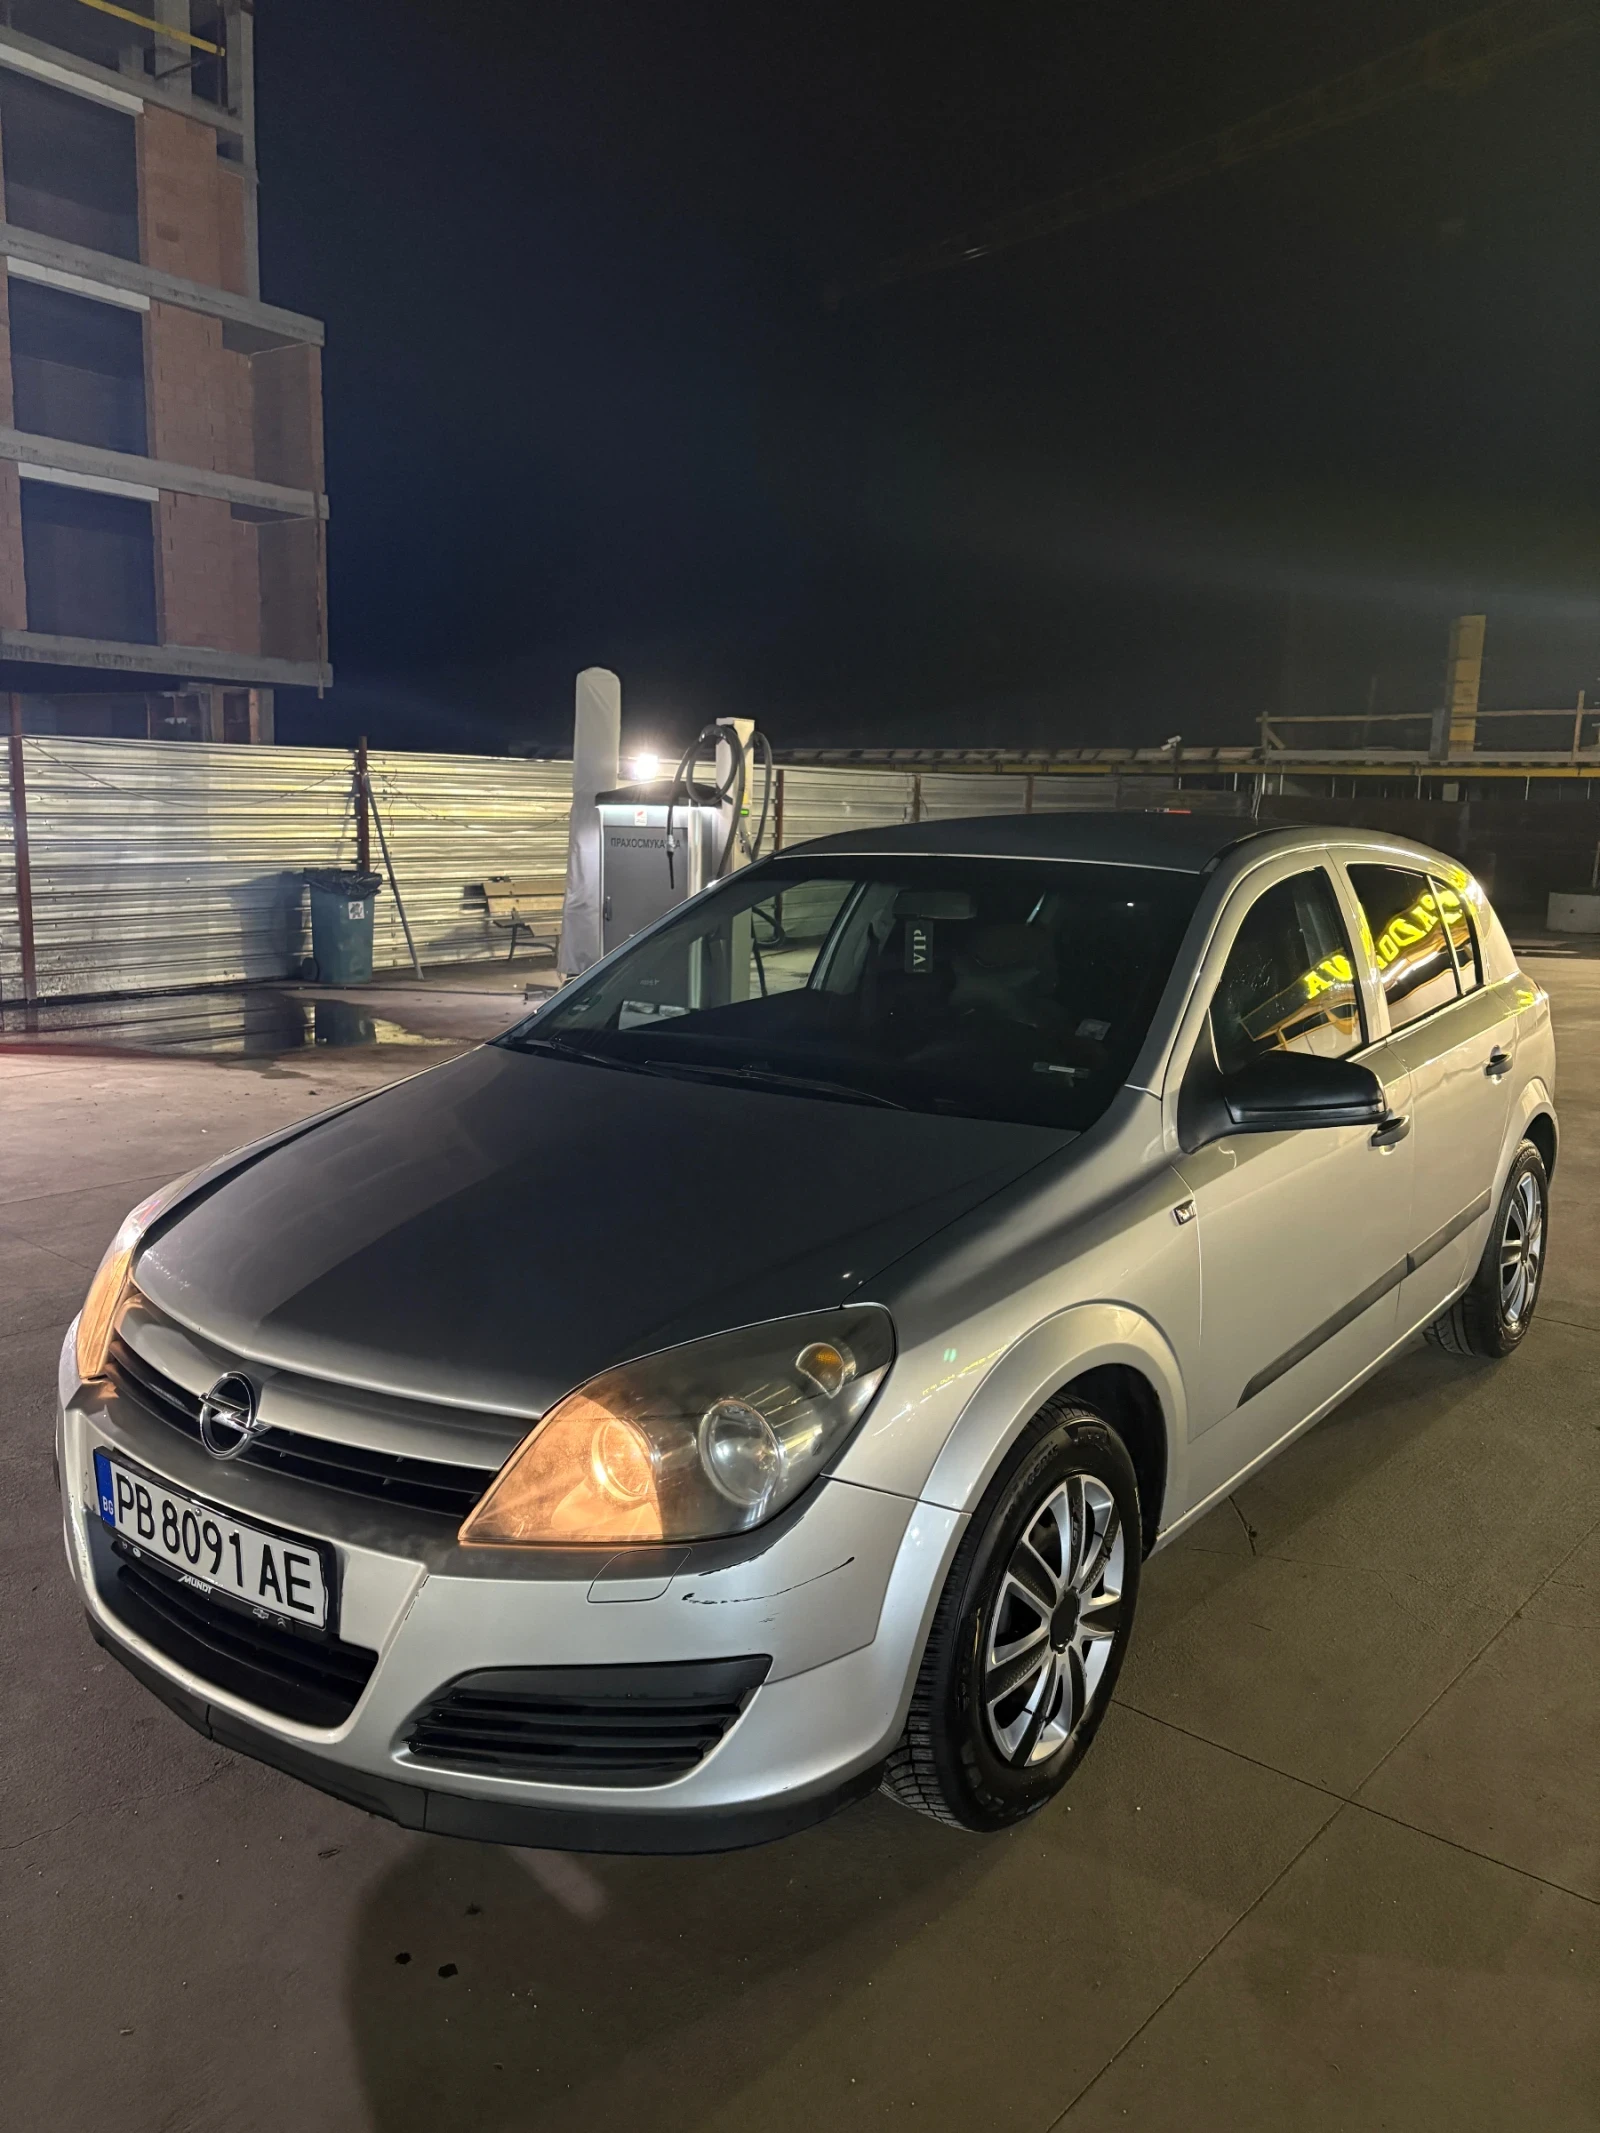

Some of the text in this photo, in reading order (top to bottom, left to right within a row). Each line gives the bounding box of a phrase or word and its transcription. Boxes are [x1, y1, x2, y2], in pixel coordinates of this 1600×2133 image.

[611, 837, 681, 849] ПРАХОСМУКАА
[913, 929, 927, 966] VIP
[102, 1496, 114, 1516] BG
[115, 1471, 315, 1615] PB 8091 AE
